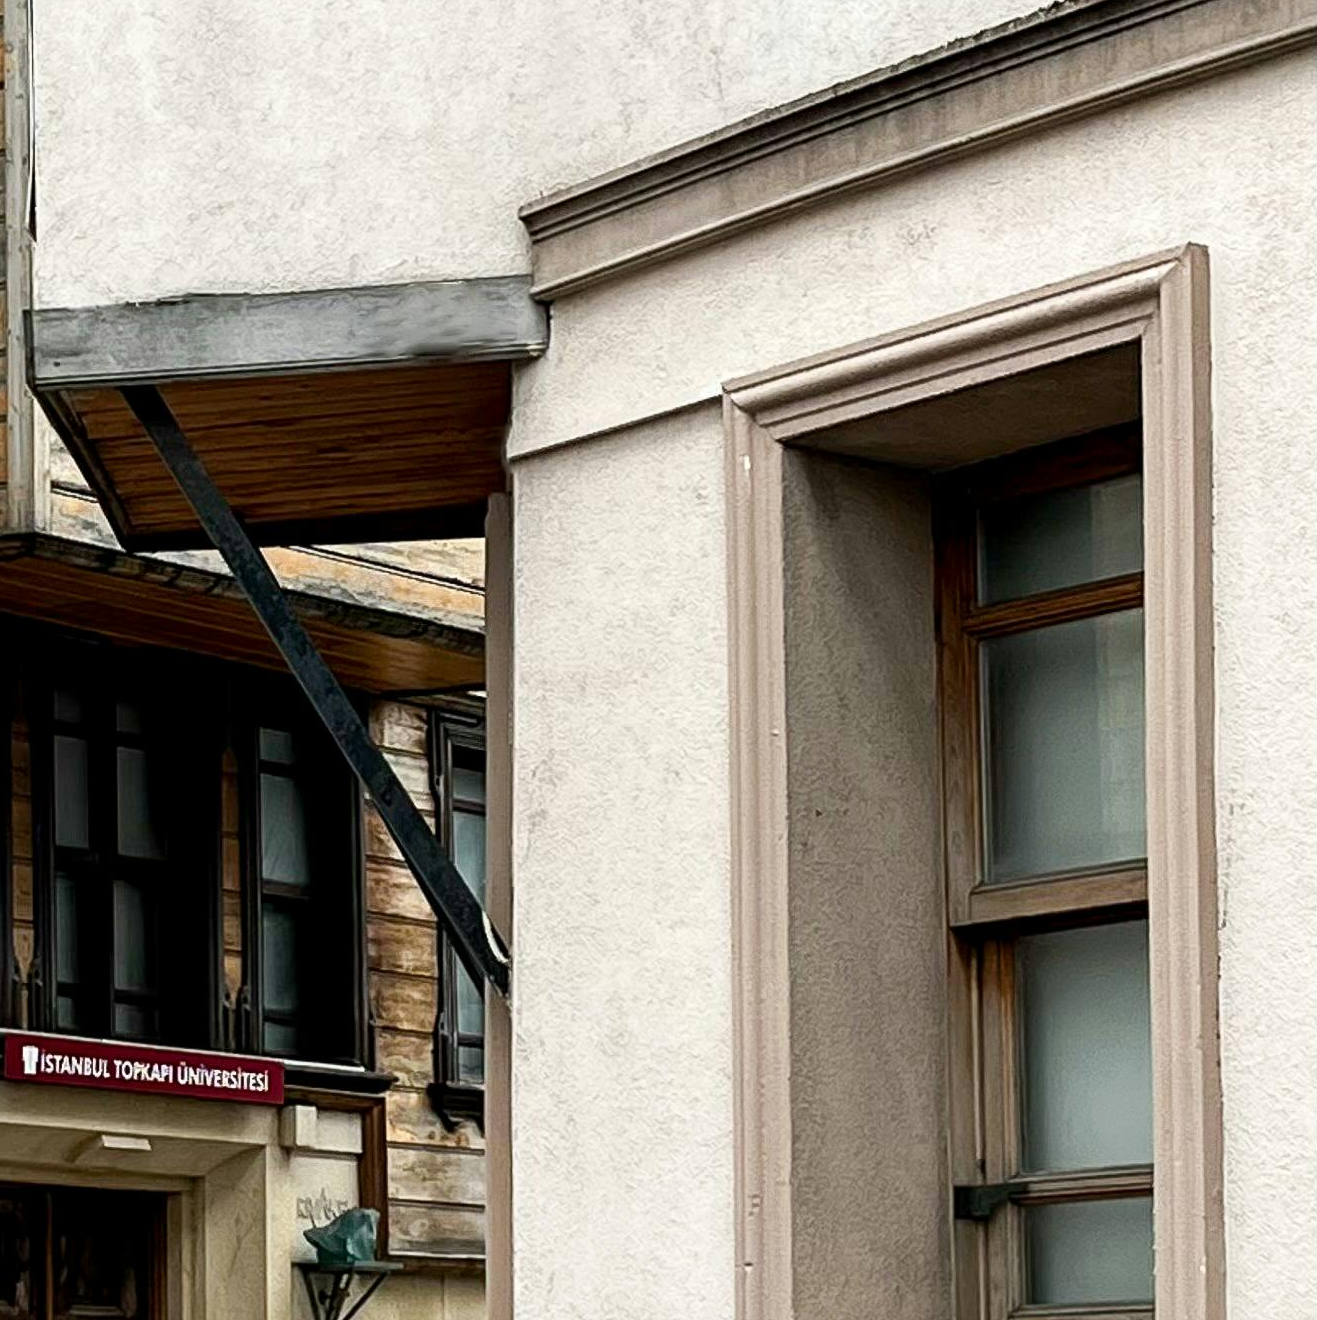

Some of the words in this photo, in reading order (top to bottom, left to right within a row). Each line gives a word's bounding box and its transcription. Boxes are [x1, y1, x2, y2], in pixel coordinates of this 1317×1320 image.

[40, 1049, 110, 1077] İSTANBUL
[114, 1061, 173, 1084] TOPKAPI
[177, 1061, 269, 1092] ÜNİVERSİTESİ
